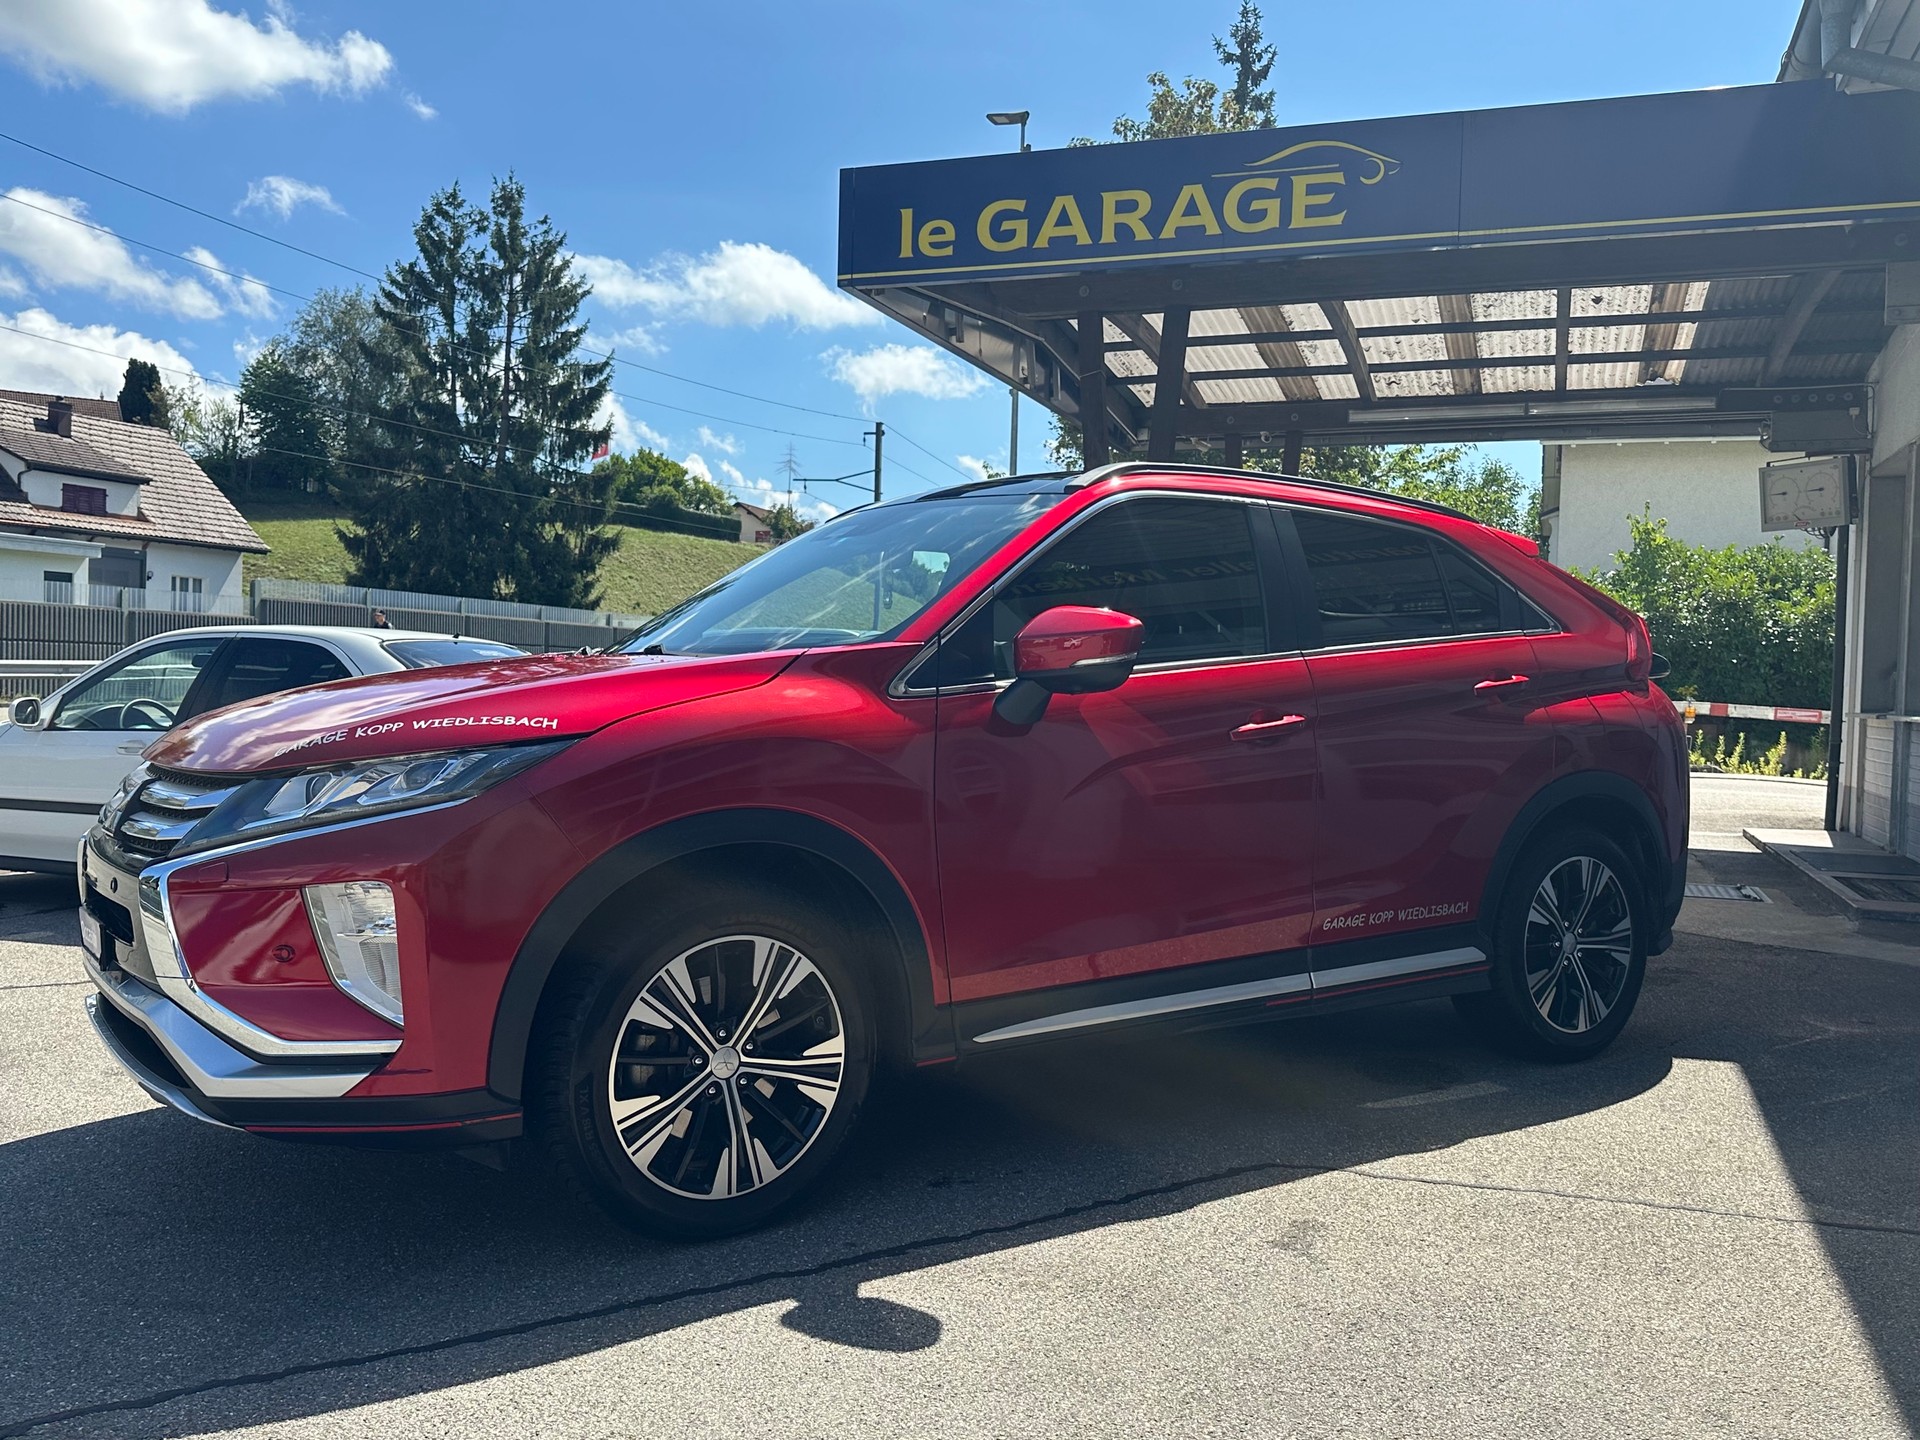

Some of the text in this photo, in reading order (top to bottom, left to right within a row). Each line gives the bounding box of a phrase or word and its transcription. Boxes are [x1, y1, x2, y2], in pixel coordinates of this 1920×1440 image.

[898, 171, 1348, 259] le GARAGE
[274, 715, 559, 757] GARAGE KOPP WIEDLISBACH
[1322, 901, 1469, 931] GARAGE KOPP WIEDLISBACH
